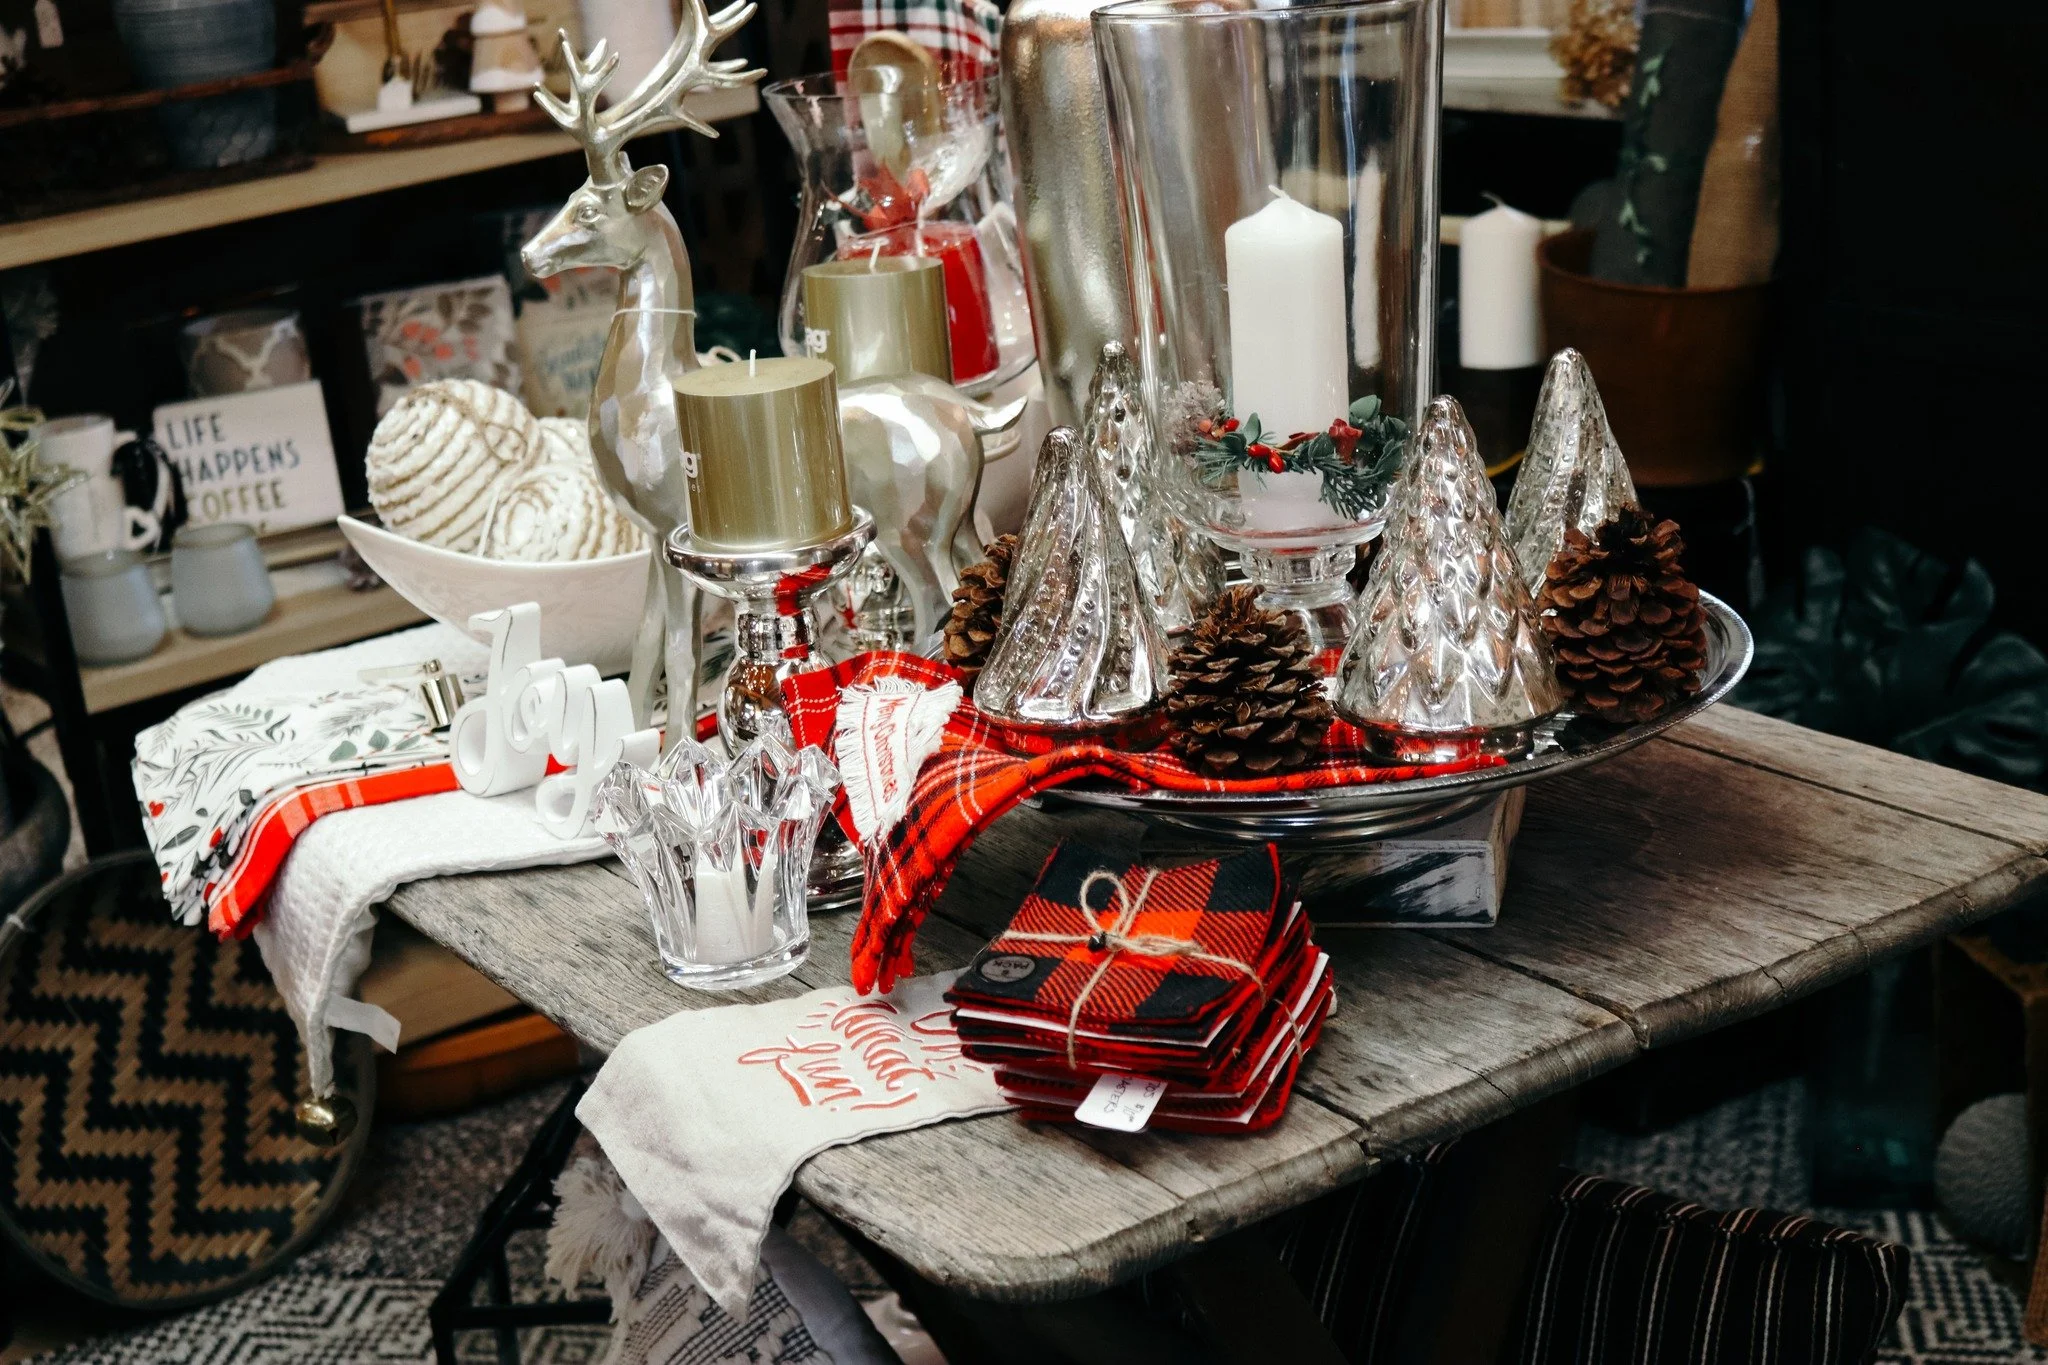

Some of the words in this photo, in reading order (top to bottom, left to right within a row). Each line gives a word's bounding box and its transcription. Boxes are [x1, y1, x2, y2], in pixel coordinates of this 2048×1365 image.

[166, 412, 227, 450] LIFE
[176, 439, 301, 485] HAPPENS
[874, 722, 899, 804] Christmas
